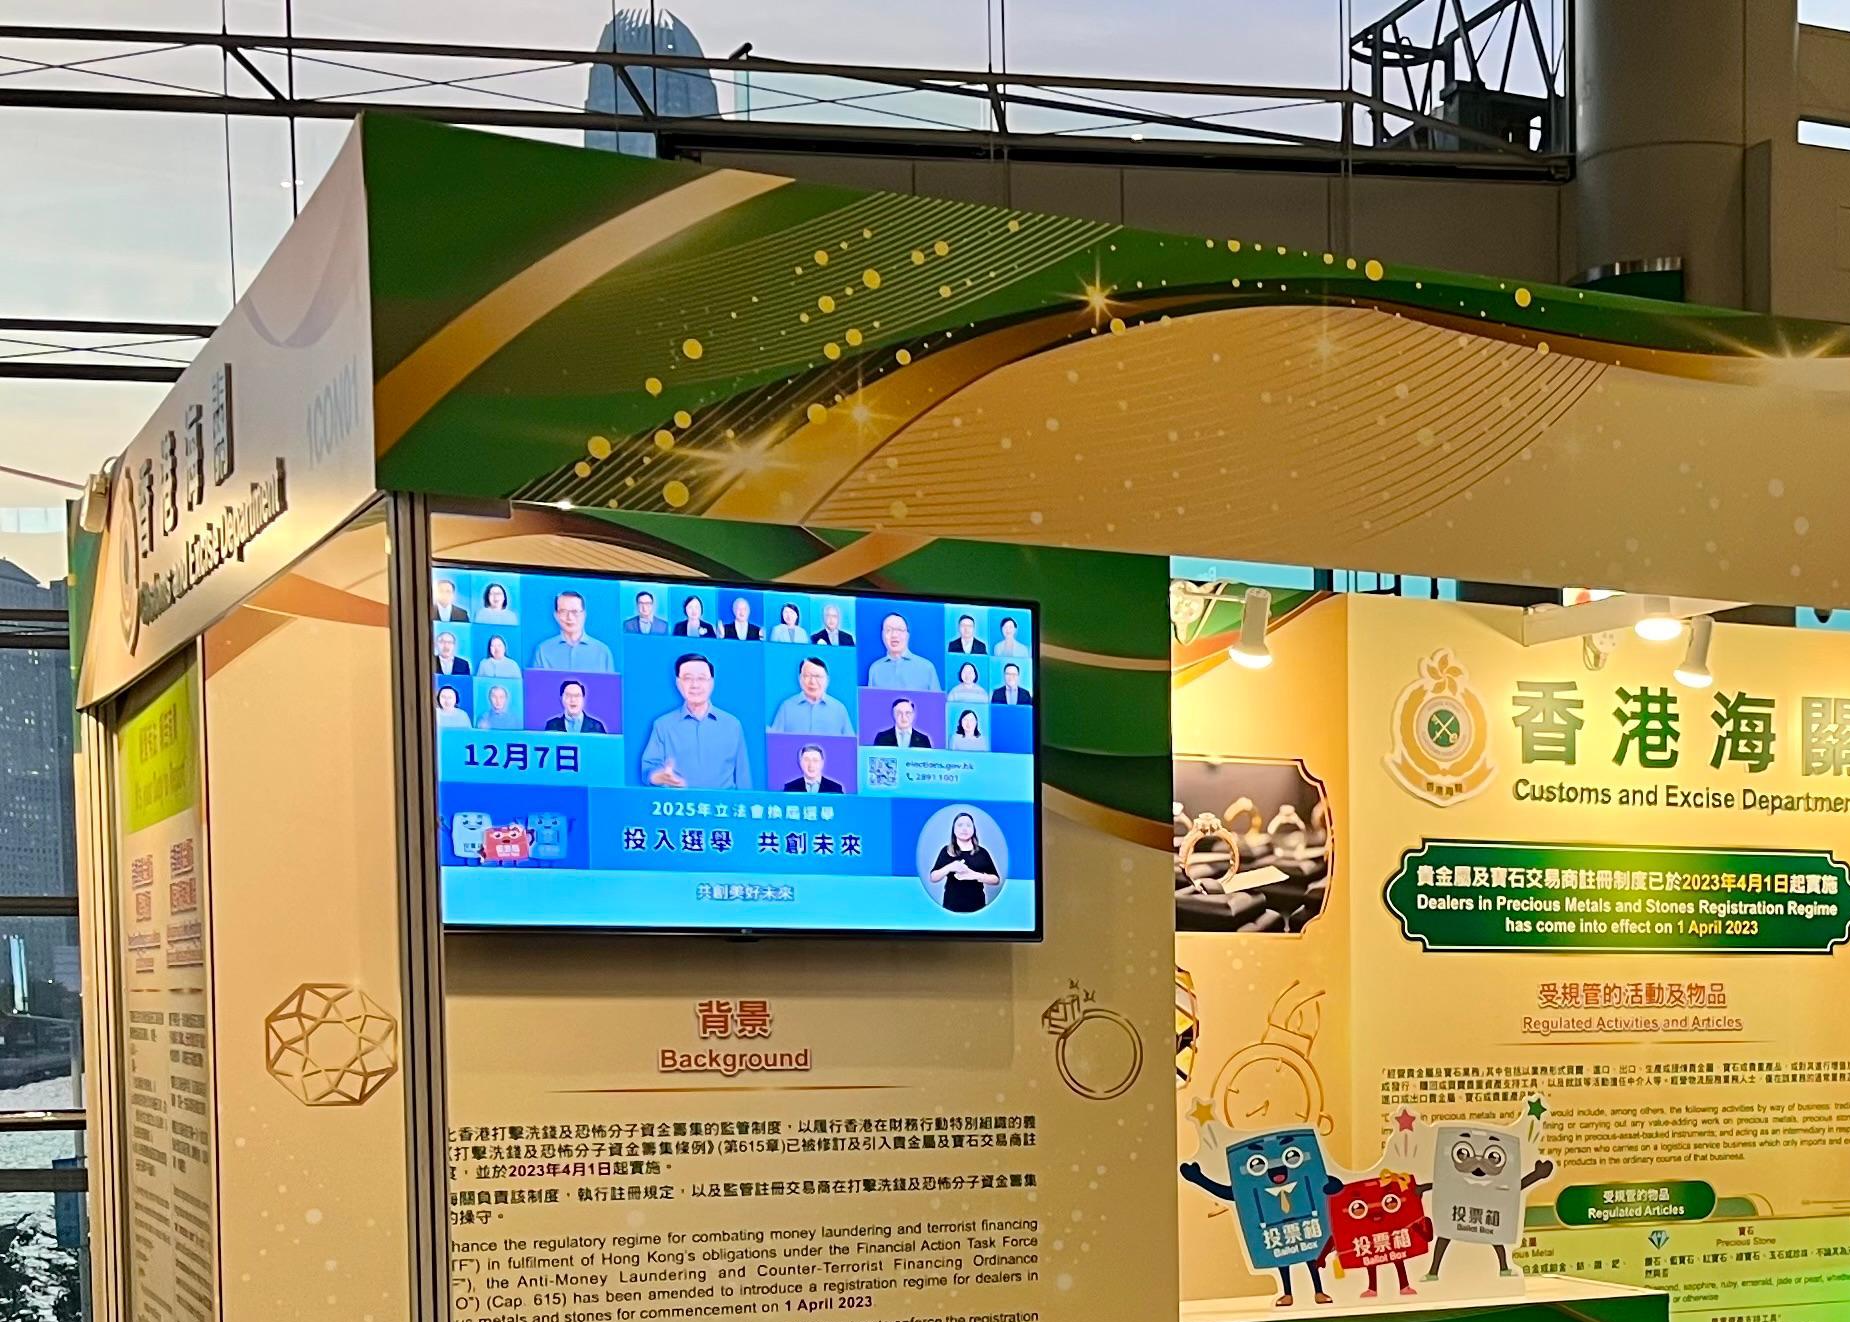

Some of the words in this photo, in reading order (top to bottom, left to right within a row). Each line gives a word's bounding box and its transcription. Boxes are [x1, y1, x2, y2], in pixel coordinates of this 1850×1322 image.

[464, 742, 580, 774] 12月7日
[1513, 778, 1612, 807] Customs
[1617, 783, 1658, 807] and
[1664, 785, 1735, 810] Excise
[623, 827, 732, 853] 投入選舉
[757, 830, 862, 856] 共創未來
[697, 882, 795, 902] 共創美好未來
[1417, 894, 1474, 910] Dealers
[1478, 895, 1493, 911] in
[1496, 897, 1561, 913] Precious
[1565, 897, 1611, 913] Metals
[1615, 898, 1642, 913] and
[1645, 899, 1695, 915] Stones
[1699, 900, 1783, 918] Registration
[1787, 902, 1838, 918] Regime
[1505, 917, 1532, 933] has
[1536, 920, 1575, 933] come
[1580, 918, 1607, 933] into
[1611, 919, 1651, 934] effect
[1655, 922, 1673, 934] on
[1677, 920, 1684, 934] 1
[1689, 920, 1721, 937] April
[1725, 921, 1759, 936] 2023
[1538, 981, 1727, 1009] 受規管的活動及物品
[696, 1000, 774, 1041] 背景
[1522, 1015, 1591, 1035] Regulated
[1595, 1015, 1658, 1033] Activities
[1662, 1016, 1689, 1031] and
[1692, 1015, 1743, 1031] Articles
[659, 1048, 812, 1074] Background
[1451, 1204, 1500, 1227] 投票箱
[1588, 1206, 1642, 1221] Regulated
[1644, 1204, 1685, 1216] Articles
[504, 1238, 526, 1250] the
[533, 1235, 606, 1252] regulatory
[612, 1233, 662, 1247] regime
[668, 1232, 686, 1244] for
[692, 1229, 764, 1242] combating
[770, 1228, 816, 1241] money
[822, 1223, 892, 1240] laundering
[897, 1222, 922, 1235] and
[927, 1220, 976, 1234] terrorist
[981, 1218, 1038, 1232] financing
[1262, 1218, 1323, 1249] 投票箱
[1352, 1228, 1412, 1257] 投票箱
[564, 1310, 612, 1322] stones
[616, 1308, 636, 1320] for
[640, 1302, 757, 1318] commencement
[762, 1302, 779, 1312] on
[785, 1300, 791, 1311] 1
[797, 1297, 833, 1312] April
[838, 1296, 872, 1309] 2023
